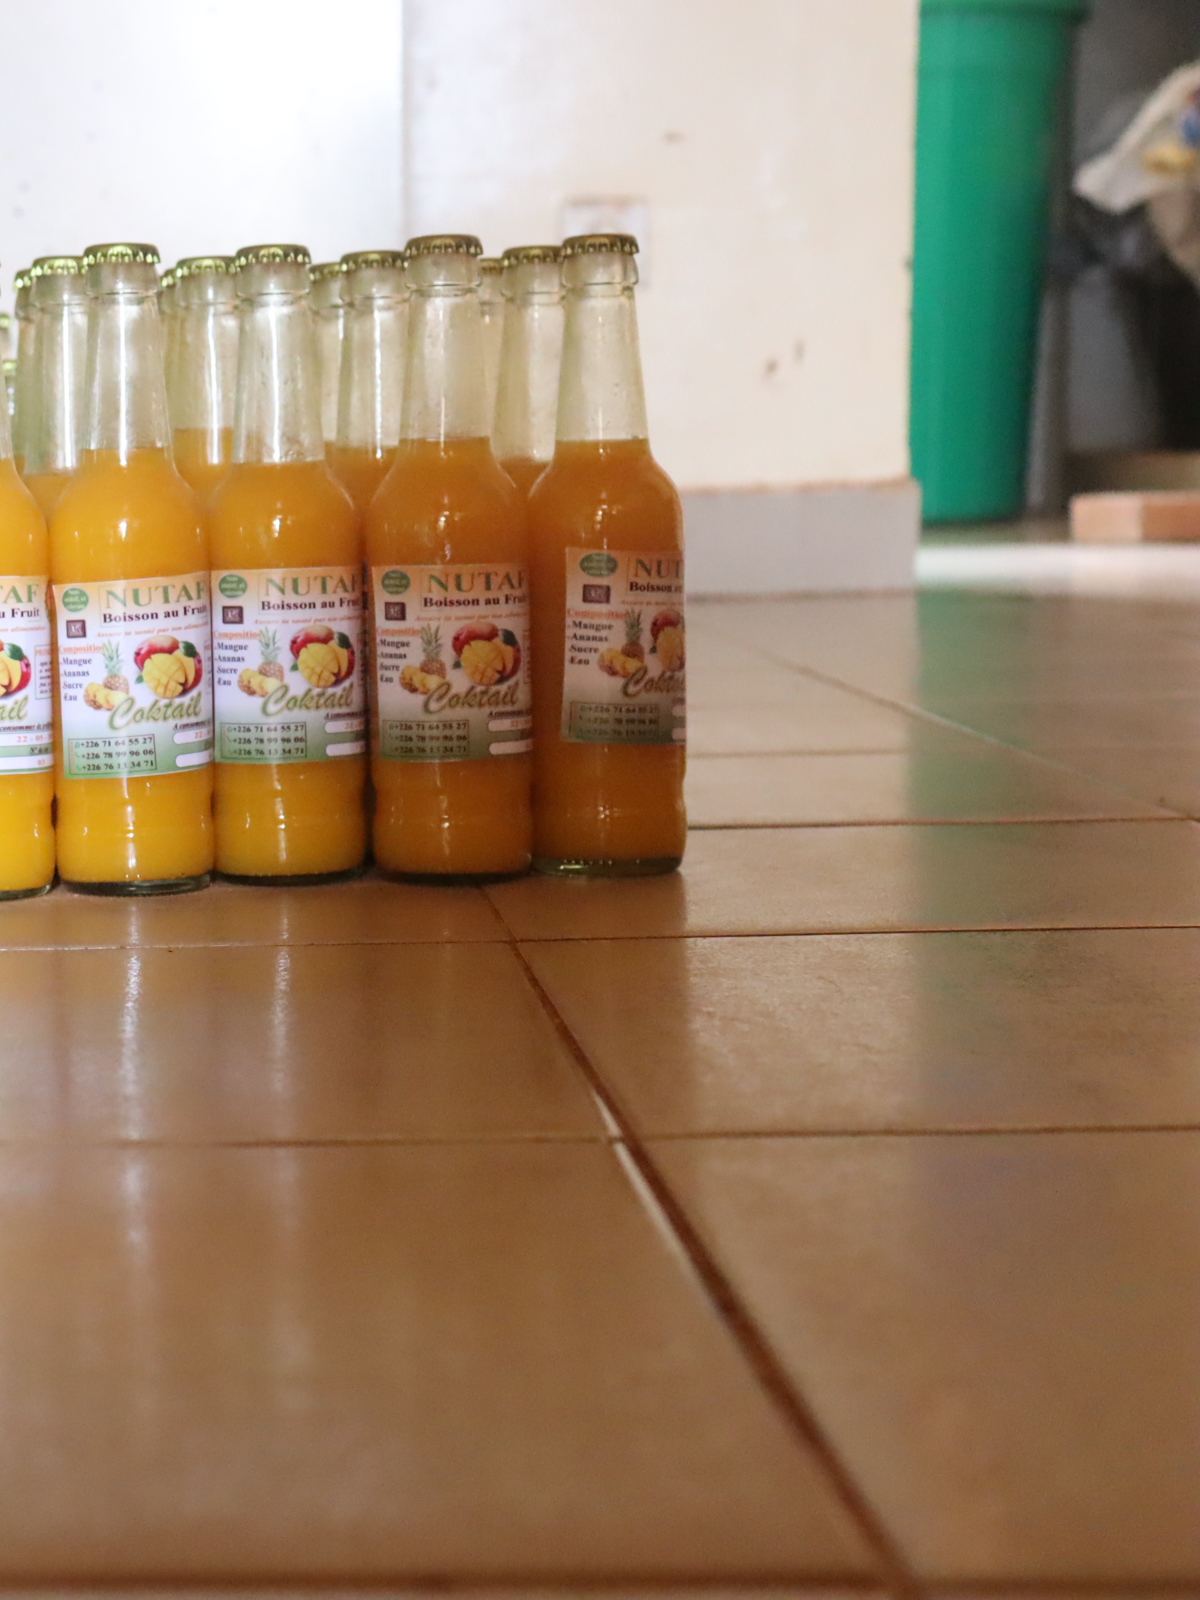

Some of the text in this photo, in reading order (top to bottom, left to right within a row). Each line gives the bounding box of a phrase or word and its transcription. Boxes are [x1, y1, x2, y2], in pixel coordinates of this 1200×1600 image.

[630, 582, 672, 592] Boisson
[261, 600, 316, 611] Boisson
[320, 600, 335, 608] au
[423, 597, 480, 608] Boisson
[484, 597, 500, 606] au
[11, 608, 40, 618] Fruit
[102, 604, 208, 624] Boisson au Fruit
[572, 620, 614, 631] Mangue
[572, 633, 608, 642] Ananas
[217, 642, 248, 652] Mangue
[380, 638, 410, 649] Mangue
[569, 644, 599, 653] Sucre
[217, 654, 245, 662] Ananas
[380, 652, 406, 660] Ananas
[570, 656, 590, 665] Eau
[62, 657, 92, 667] Mangue
[380, 662, 400, 671] Sucre
[216, 666, 238, 674] Sucre
[217, 677, 232, 686] Eau
[380, 674, 394, 683] Eau
[62, 681, 84, 690] Sucre
[64, 693, 78, 702] Eau
[261, 682, 354, 717] Coktail
[423, 679, 520, 714] Coktail
[108, 692, 202, 730] Coktail
[416, 722, 426, 730] 71
[428, 722, 440, 730] 64
[442, 722, 453, 730] 55
[456, 722, 467, 730] 27
[80, 740, 100, 748] +226
[128, 738, 140, 746] 55
[142, 736, 153, 744] 27
[82, 752, 100, 760] +226
[82, 764, 101, 772] +226
[117, 762, 128, 770] 13
